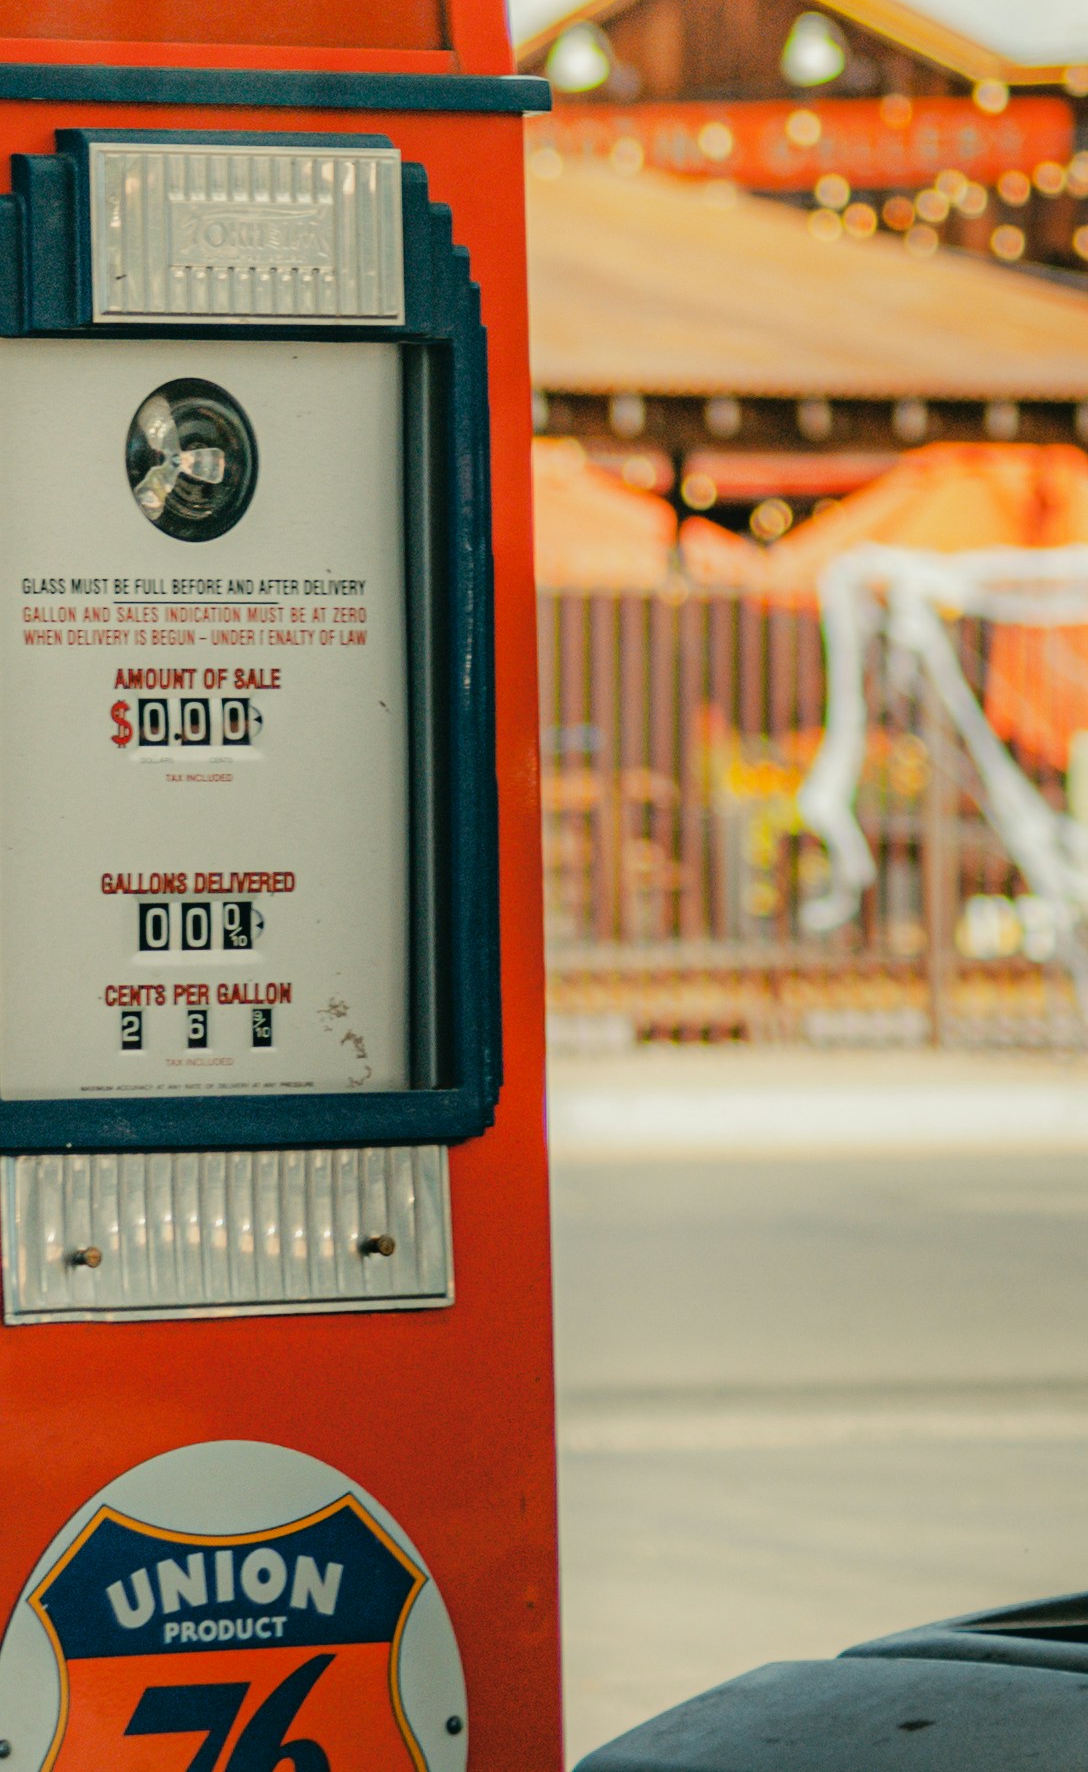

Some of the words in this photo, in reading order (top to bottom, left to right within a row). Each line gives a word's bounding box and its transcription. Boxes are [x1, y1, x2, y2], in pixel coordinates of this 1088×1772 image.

[22, 578, 66, 595] GLASS
[71, 578, 109, 595] MUST
[114, 578, 130, 595] BE
[135, 578, 167, 595] FULL
[172, 578, 222, 595] BEFORE
[228, 578, 254, 595] AND
[259, 578, 299, 595] AFTER
[304, 578, 366, 595] DELIVERY
[23, 607, 76, 623] GALLON
[83, 607, 111, 623] AND
[116, 607, 159, 623] SALES
[165, 607, 241, 623] INDICATION
[247, 607, 284, 623] MUST
[291, 607, 306, 623] BE
[313, 607, 327, 623] AT
[333, 607, 367, 623] ZERO
[24, 629, 62, 645] WHEN
[67, 629, 130, 645] DELIVERY
[134, 629, 147, 645] IS
[151, 629, 195, 645] BEGUN
[212, 629, 255, 646] UNDER
[320, 629, 335, 646] OF
[340, 629, 367, 646] LAW
[114, 668, 197, 689] AMOUNT
[203, 668, 227, 689] OF
[233, 668, 281, 689] SALE
[101, 872, 187, 894] GALLONS
[193, 871, 295, 893] DELIVERED
[105, 984, 166, 1006] CENTS
[173, 983, 210, 1005] PER
[216, 982, 292, 1005] GALLON
[106, 1547, 344, 1629] UNION
[164, 1616, 287, 1644] PRODUCT
